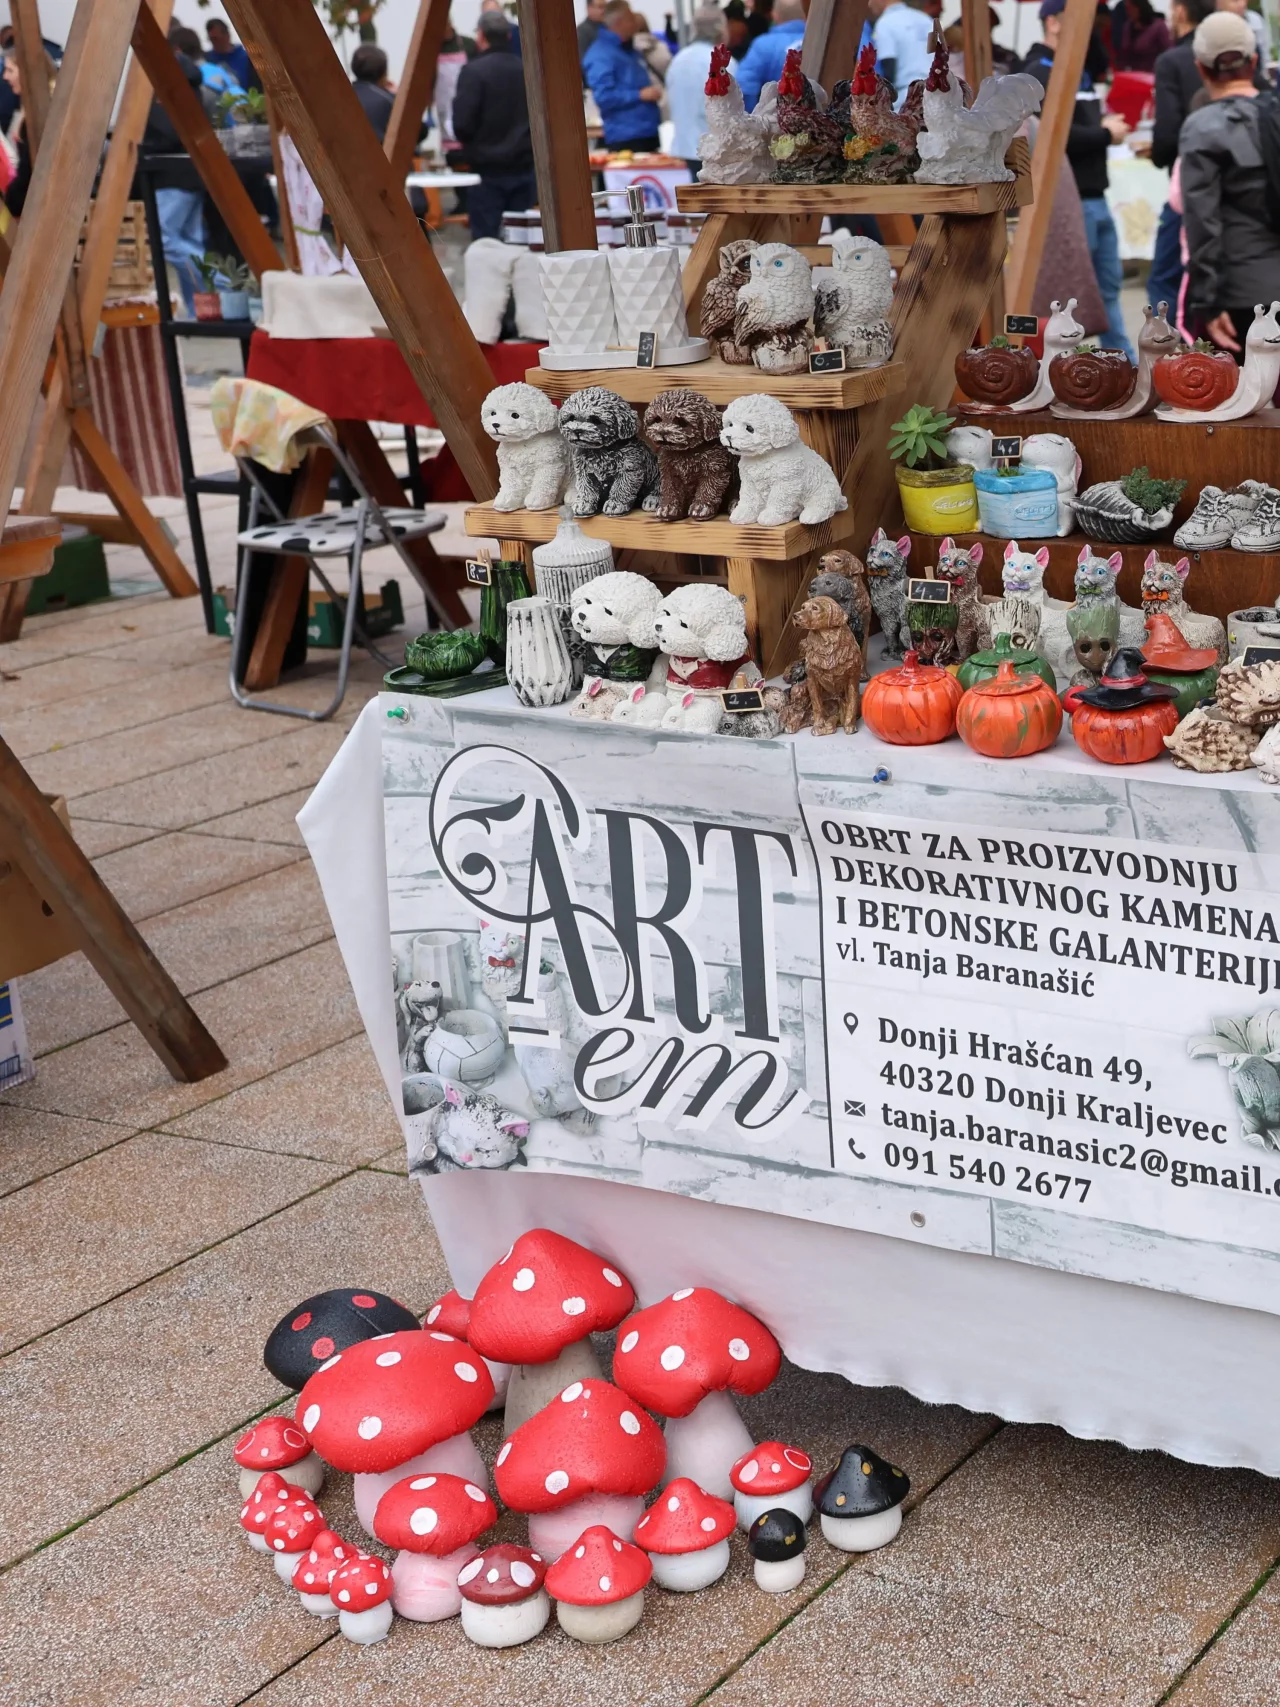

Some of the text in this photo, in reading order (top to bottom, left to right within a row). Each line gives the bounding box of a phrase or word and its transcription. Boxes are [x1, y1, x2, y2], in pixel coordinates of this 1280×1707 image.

[429, 743, 798, 1044] ART
[821, 819, 1238, 896] OBRT ZA PROIZVODNJU
[830, 855, 1280, 944] DEKORATIVNOG KAMENA
[836, 896, 847, 925] I
[858, 898, 1038, 952] BETONSKE
[836, 937, 1095, 998] vl. Tanja Baranašić
[878, 1016, 1152, 1092] Donji Hrašćan 49,
[879, 1060, 1228, 1144] 40320 Donji Kraljevec
[884, 1142, 1092, 1204] 091 540 2677
